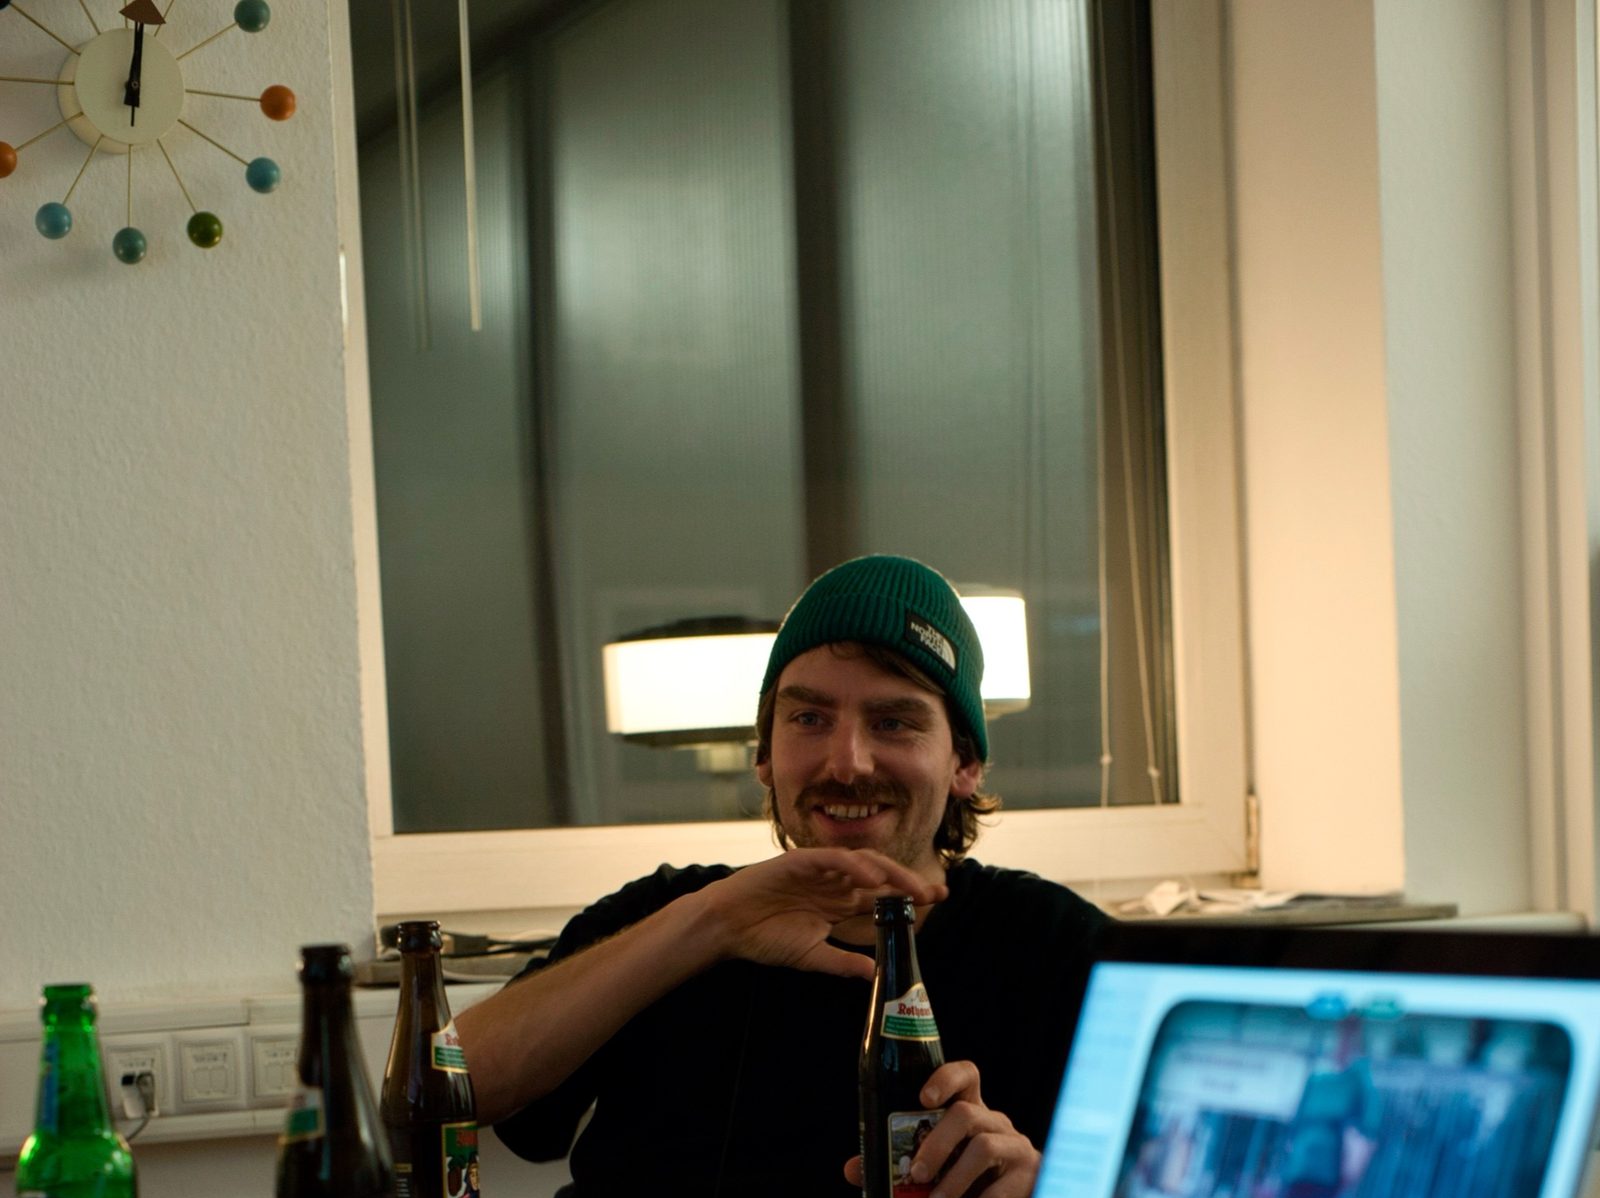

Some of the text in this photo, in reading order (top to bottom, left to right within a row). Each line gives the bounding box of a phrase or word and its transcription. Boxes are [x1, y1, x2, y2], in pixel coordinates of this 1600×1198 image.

[910, 621, 944, 647] NORTH
[919, 634, 945, 658] FACE
[898, 1003, 931, 1017] Rothau
